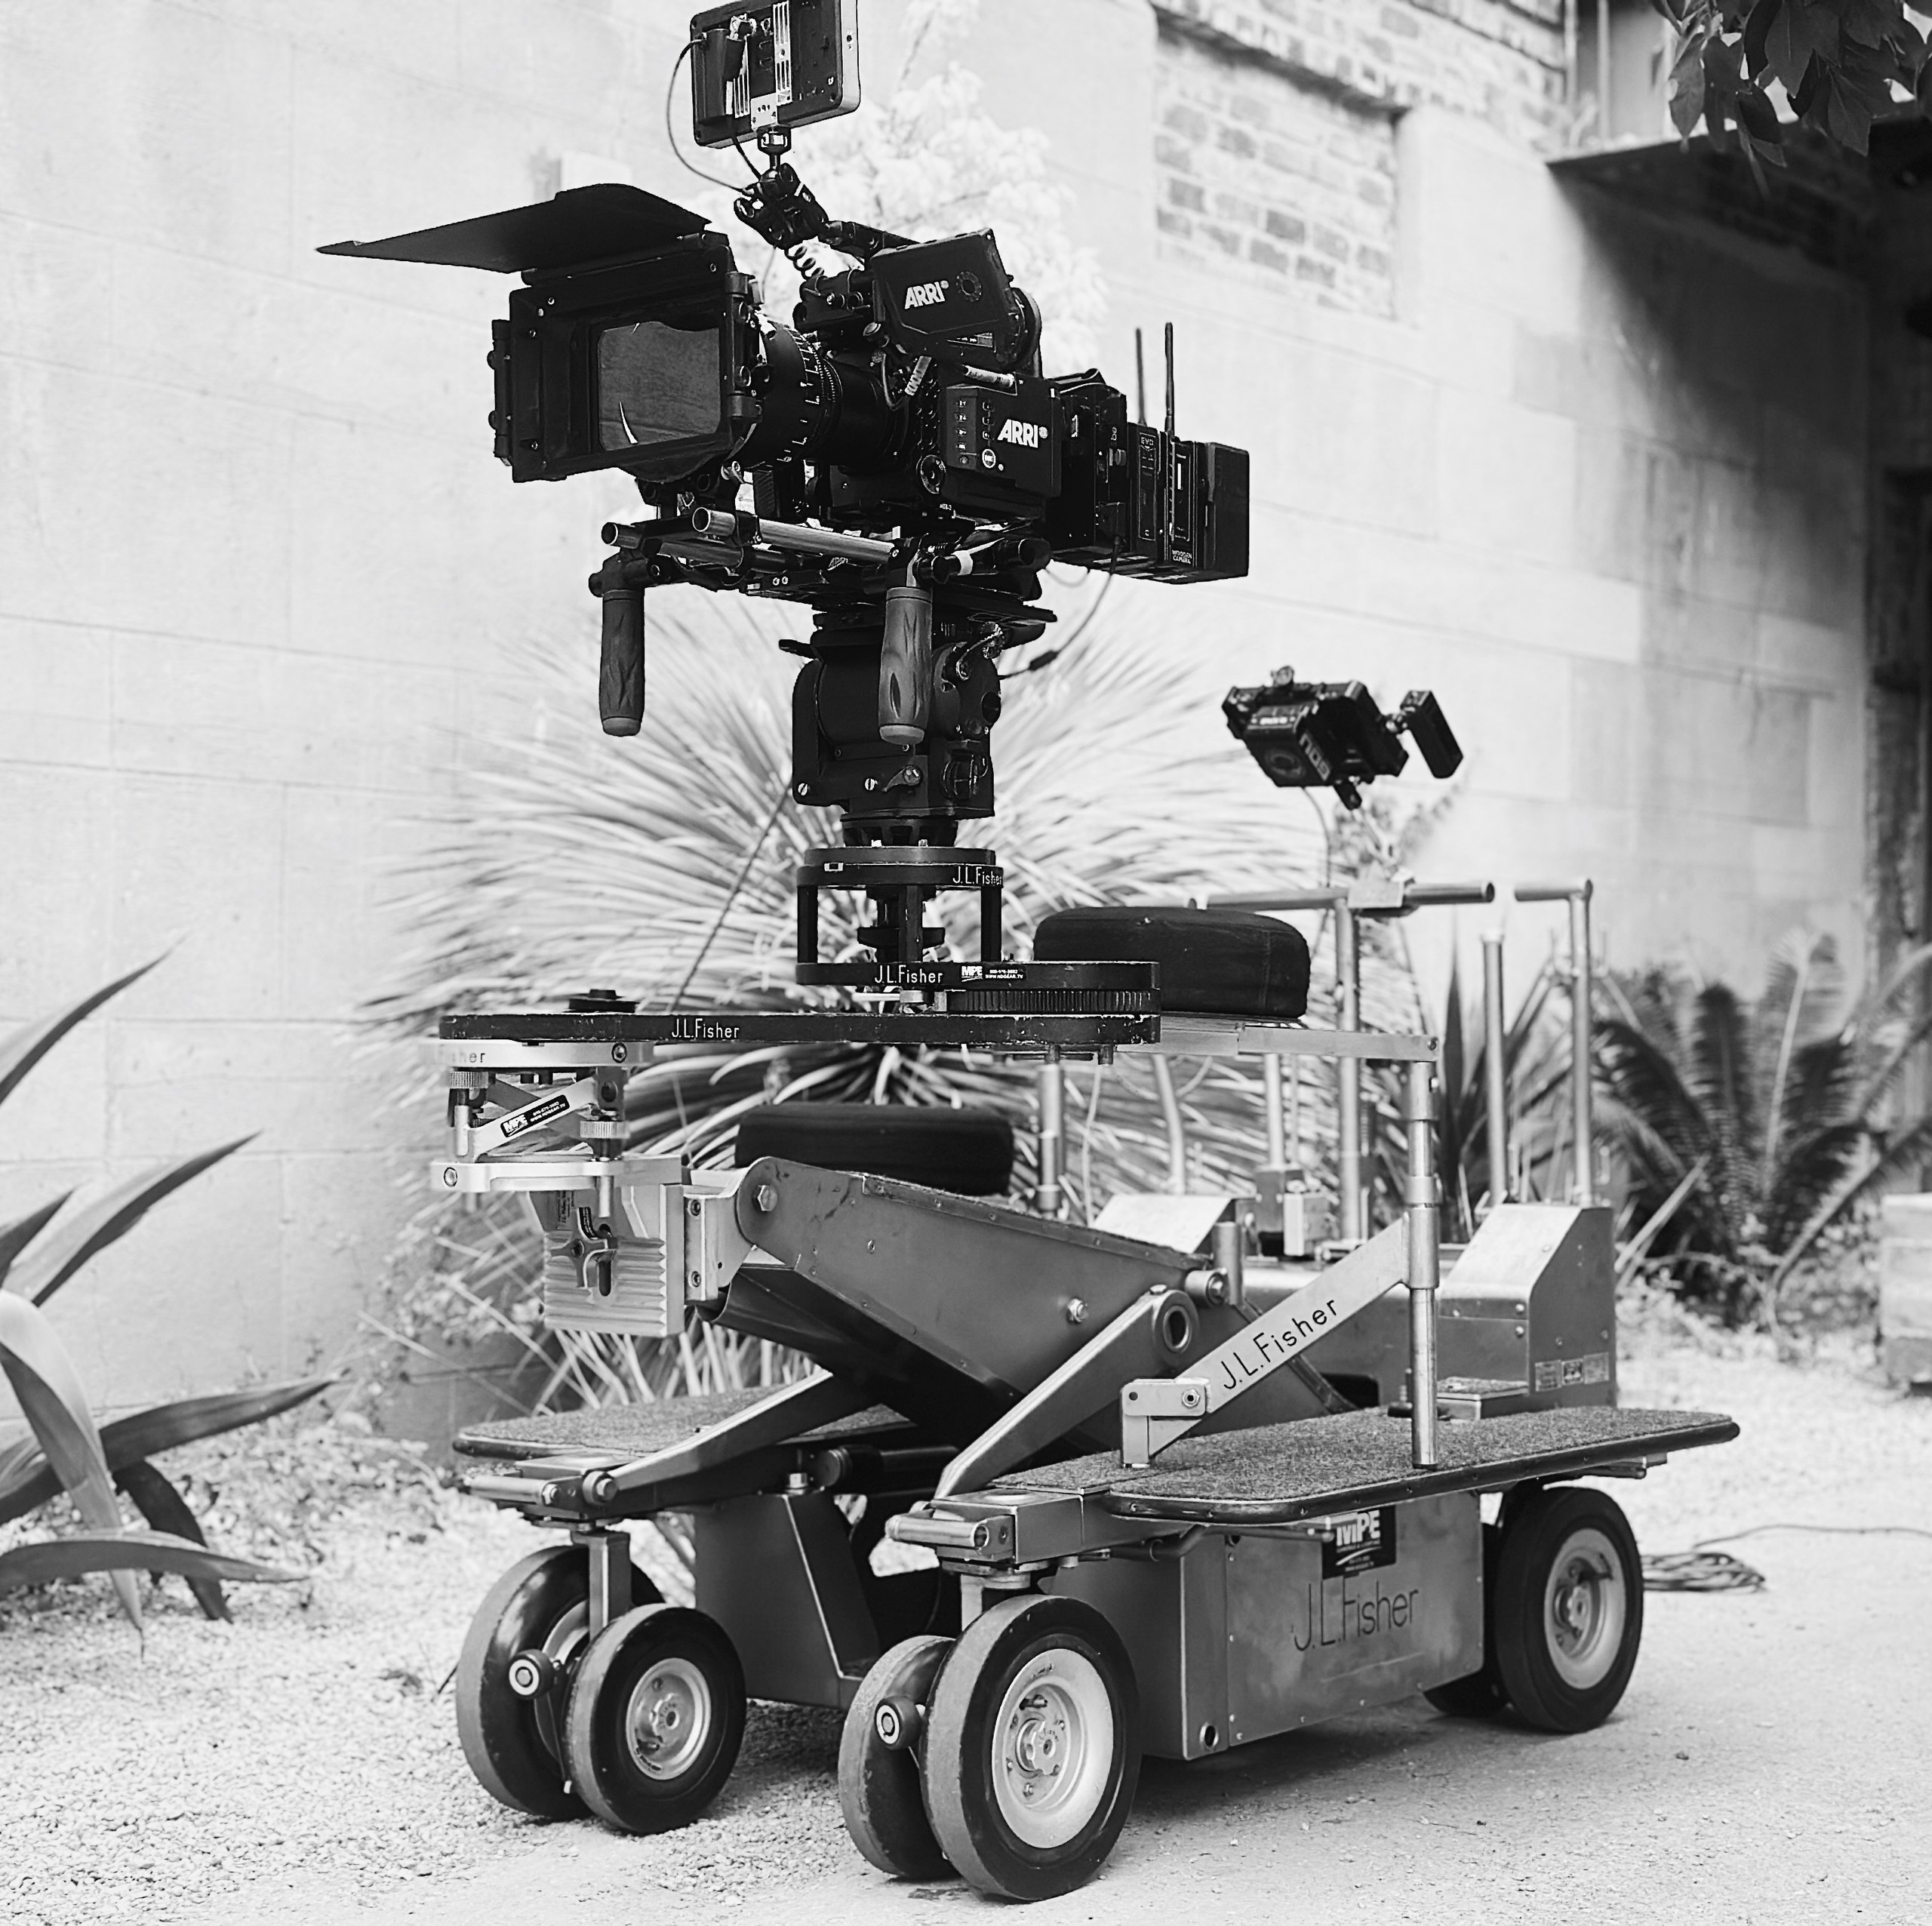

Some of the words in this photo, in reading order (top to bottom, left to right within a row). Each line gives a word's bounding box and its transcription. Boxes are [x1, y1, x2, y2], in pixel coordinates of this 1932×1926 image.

[875, 965, 943, 983] J.L.Fisher
[671, 1018, 740, 1038] J.L.Fisher
[1220, 1300, 1337, 1389] J.L.Fisher
[1336, 1509, 1380, 1546] MPE
